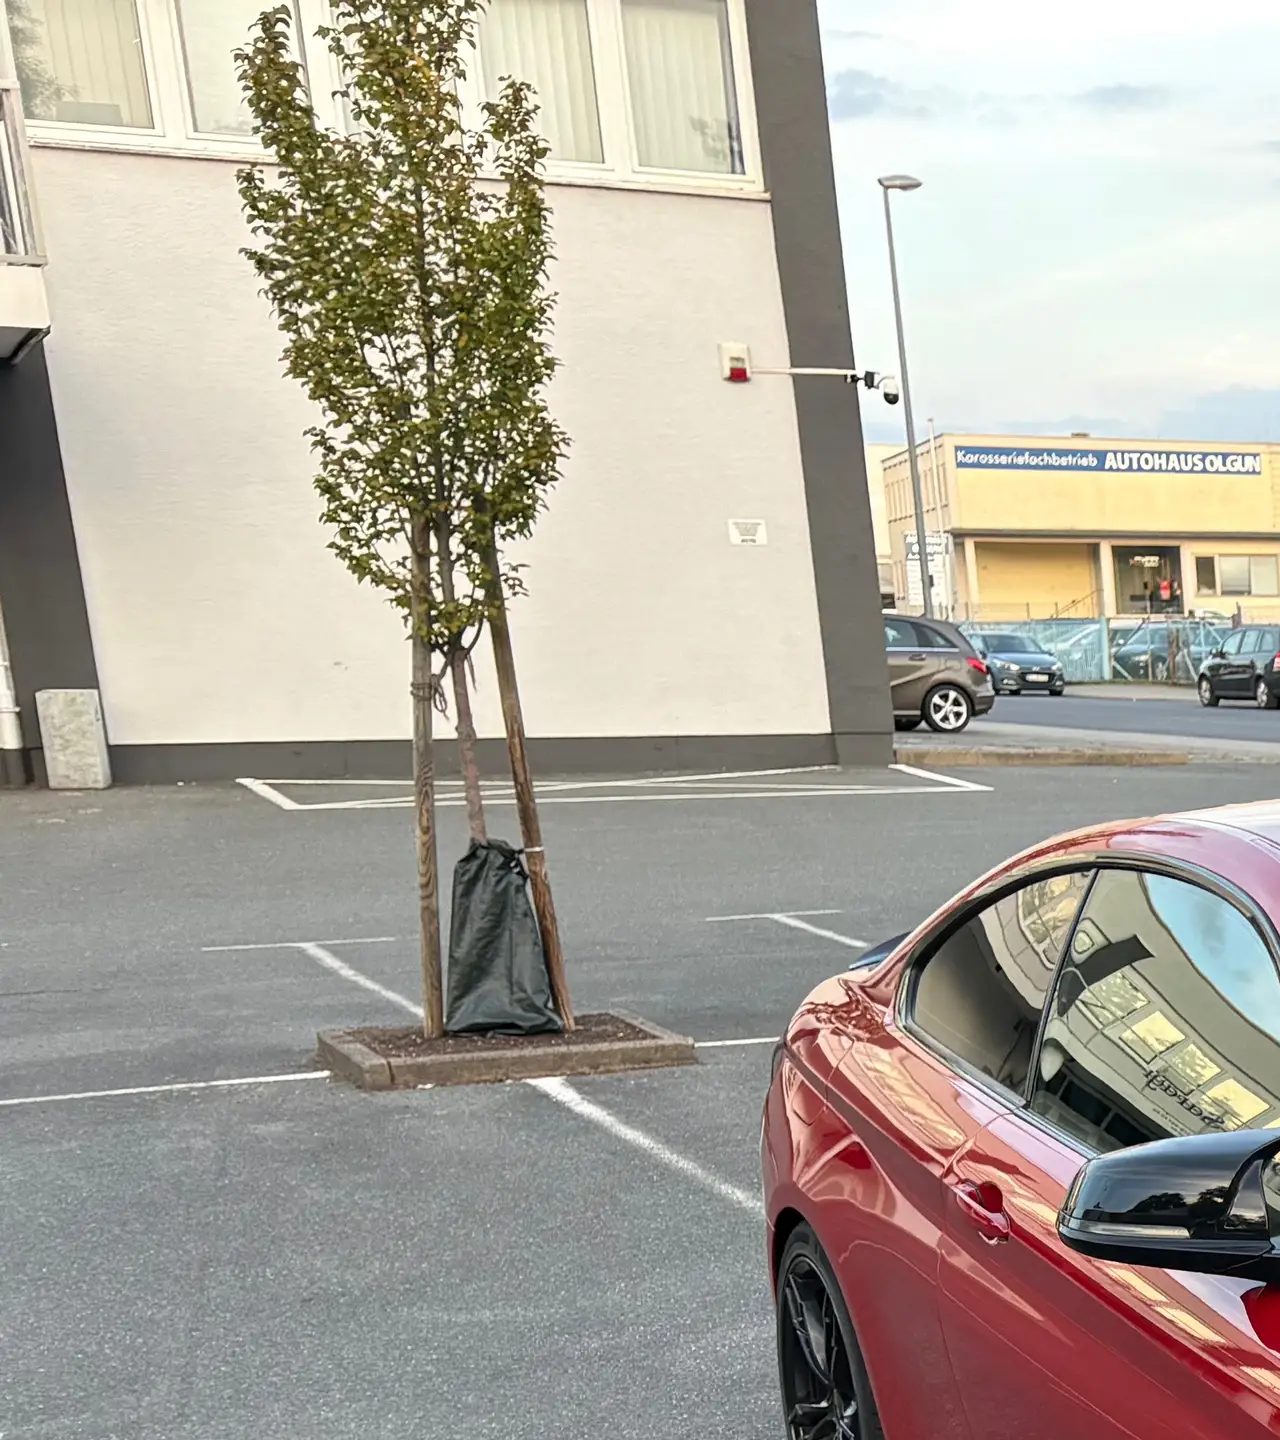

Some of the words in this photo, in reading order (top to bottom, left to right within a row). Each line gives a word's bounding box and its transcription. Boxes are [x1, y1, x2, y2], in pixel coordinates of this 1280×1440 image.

[956, 450, 1098, 467] Karosseriefachbetrieb
[1104, 452, 1203, 471] AUTOHAUS
[1204, 454, 1261, 472] OLGUN
